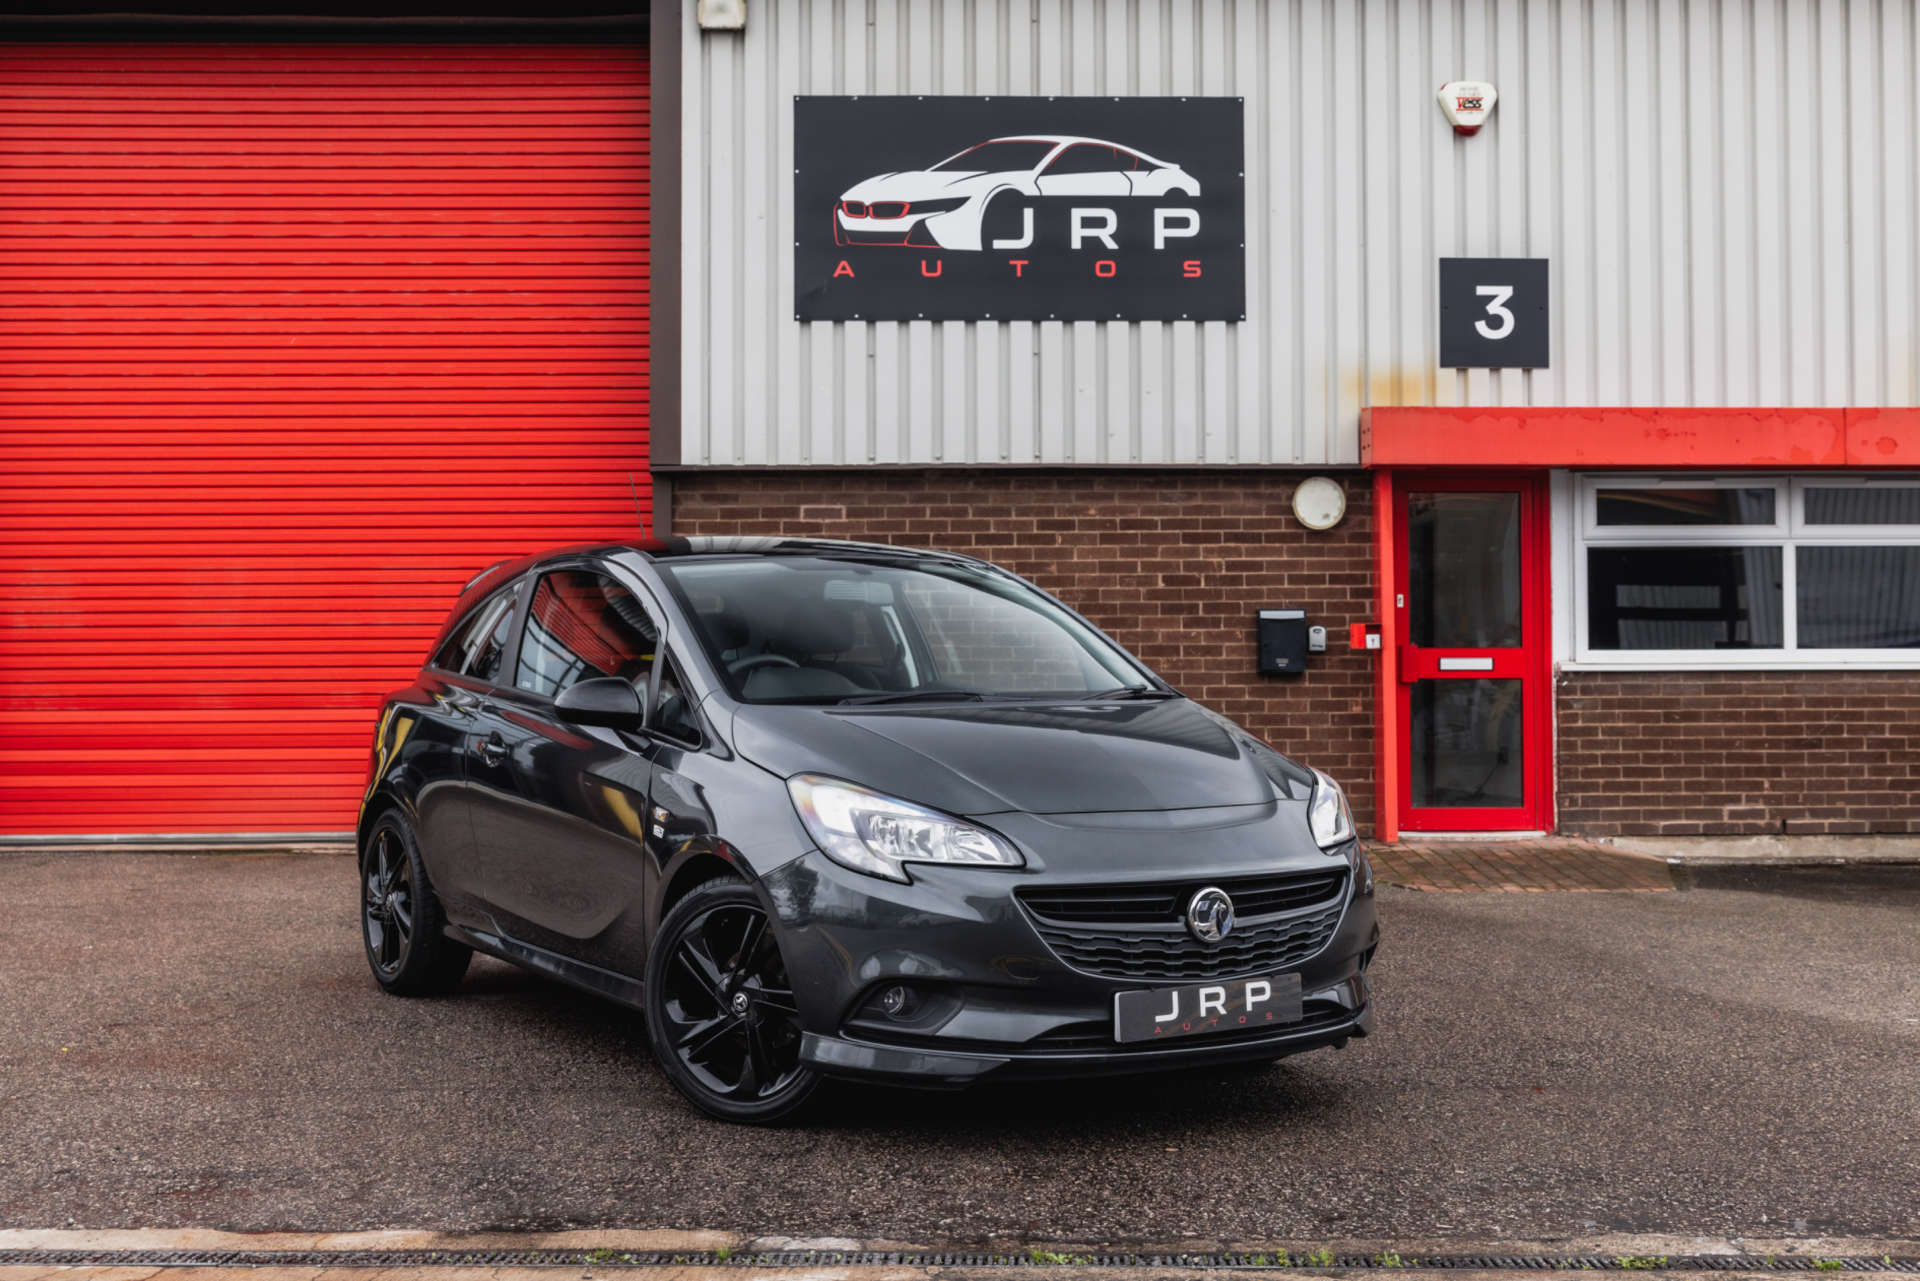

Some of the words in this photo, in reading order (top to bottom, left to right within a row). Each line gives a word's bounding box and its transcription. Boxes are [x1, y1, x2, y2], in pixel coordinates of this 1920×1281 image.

[992, 207, 1201, 250] JRP
[833, 259, 1203, 278] AUTOS
[1474, 285, 1515, 340] 3
[1154, 1012, 1273, 1034] AUTOS
[1155, 981, 1271, 1023] JRP
